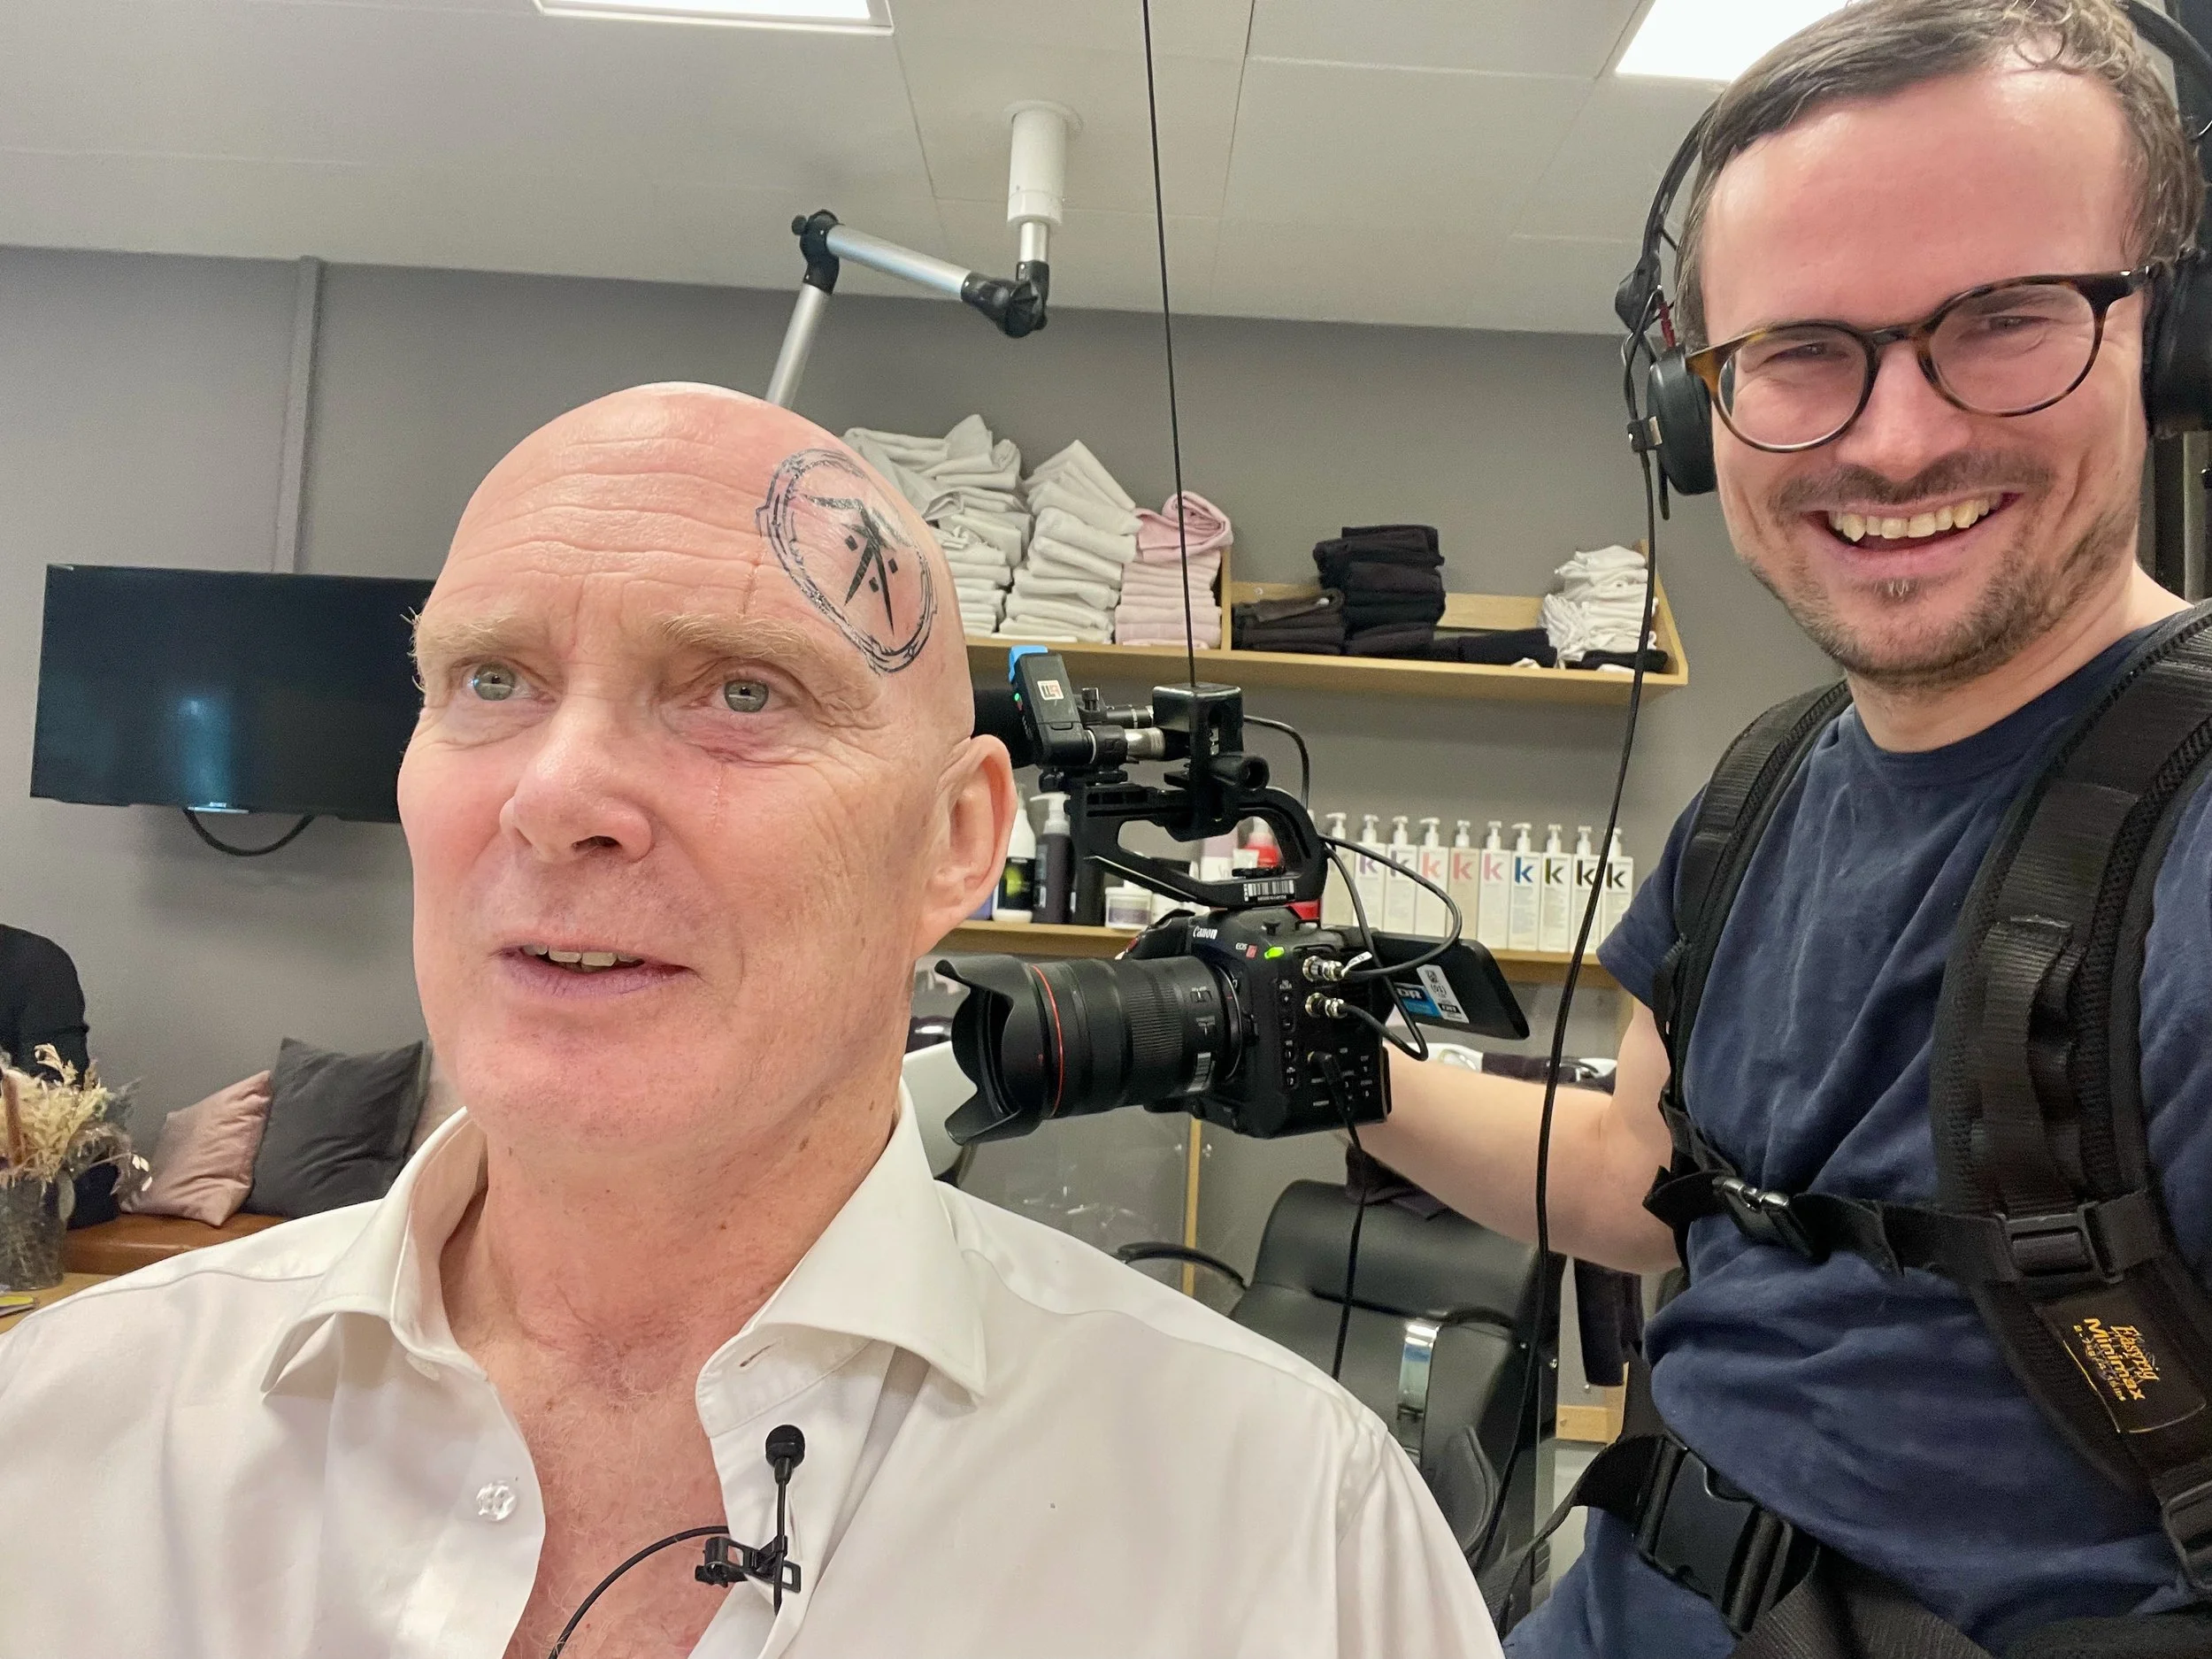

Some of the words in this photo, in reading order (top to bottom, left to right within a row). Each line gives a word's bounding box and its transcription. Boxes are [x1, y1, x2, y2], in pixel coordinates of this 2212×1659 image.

[1359, 850, 1379, 875] k
[1421, 852, 1441, 879] k
[1452, 853, 1473, 880] k
[1484, 853, 1504, 881] k
[1515, 856, 1534, 884] k
[1545, 857, 1564, 885] k
[1576, 859, 1596, 887] k
[1606, 862, 1625, 889] k
[1193, 926, 1218, 940] Canon
[1235, 942, 1248, 951] EOS
[2084, 1317, 2146, 1401] Minimax
[2110, 1325, 2160, 1381] Easyrig
